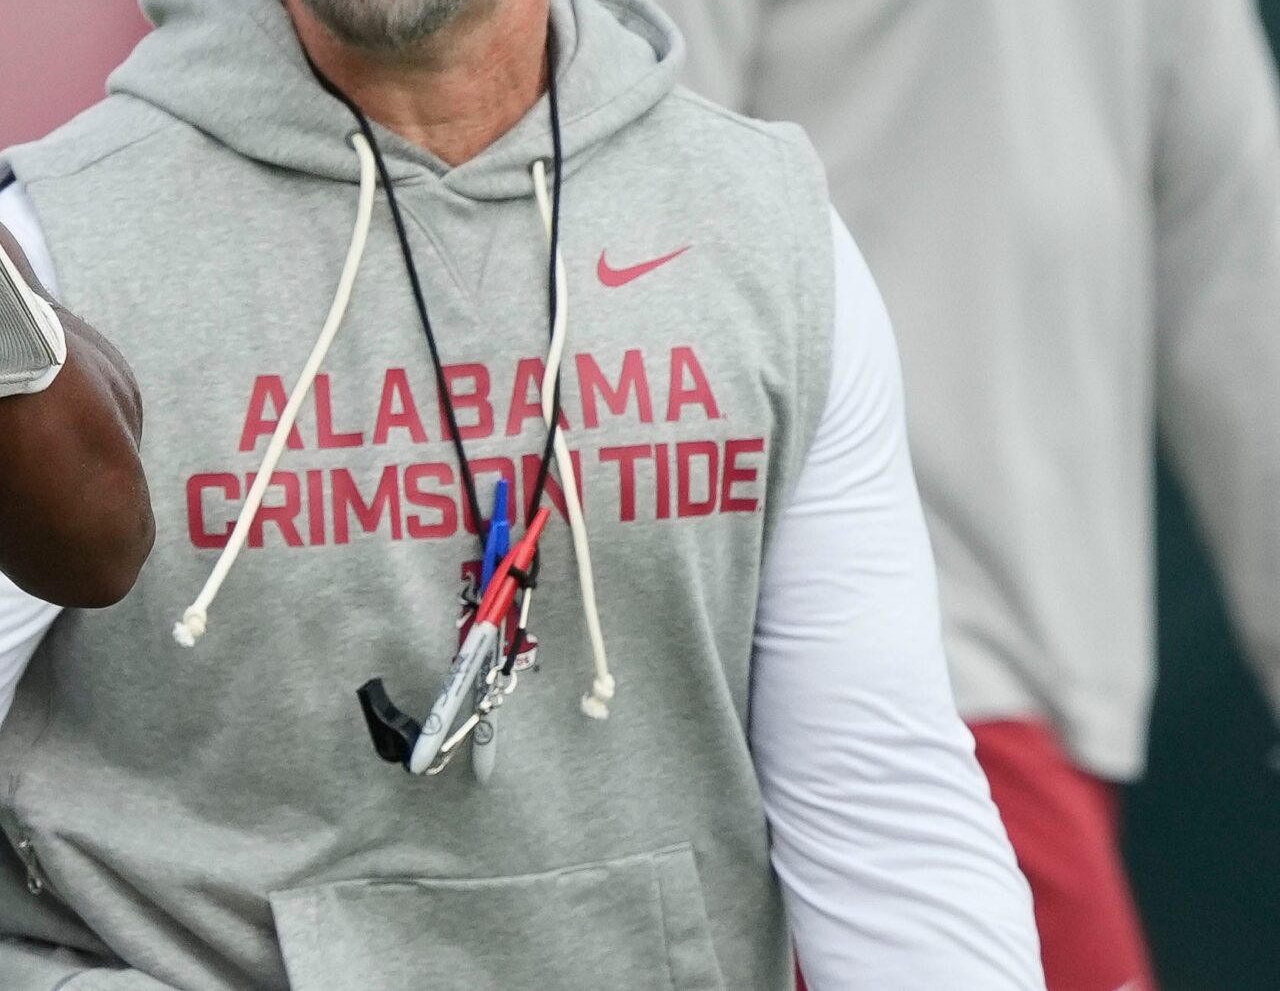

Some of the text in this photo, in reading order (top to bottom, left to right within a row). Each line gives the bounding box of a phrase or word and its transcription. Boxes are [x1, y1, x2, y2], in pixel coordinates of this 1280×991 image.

[239, 346, 722, 452] ALABAMA
[186, 436, 766, 549] CRIMSON TIDE
